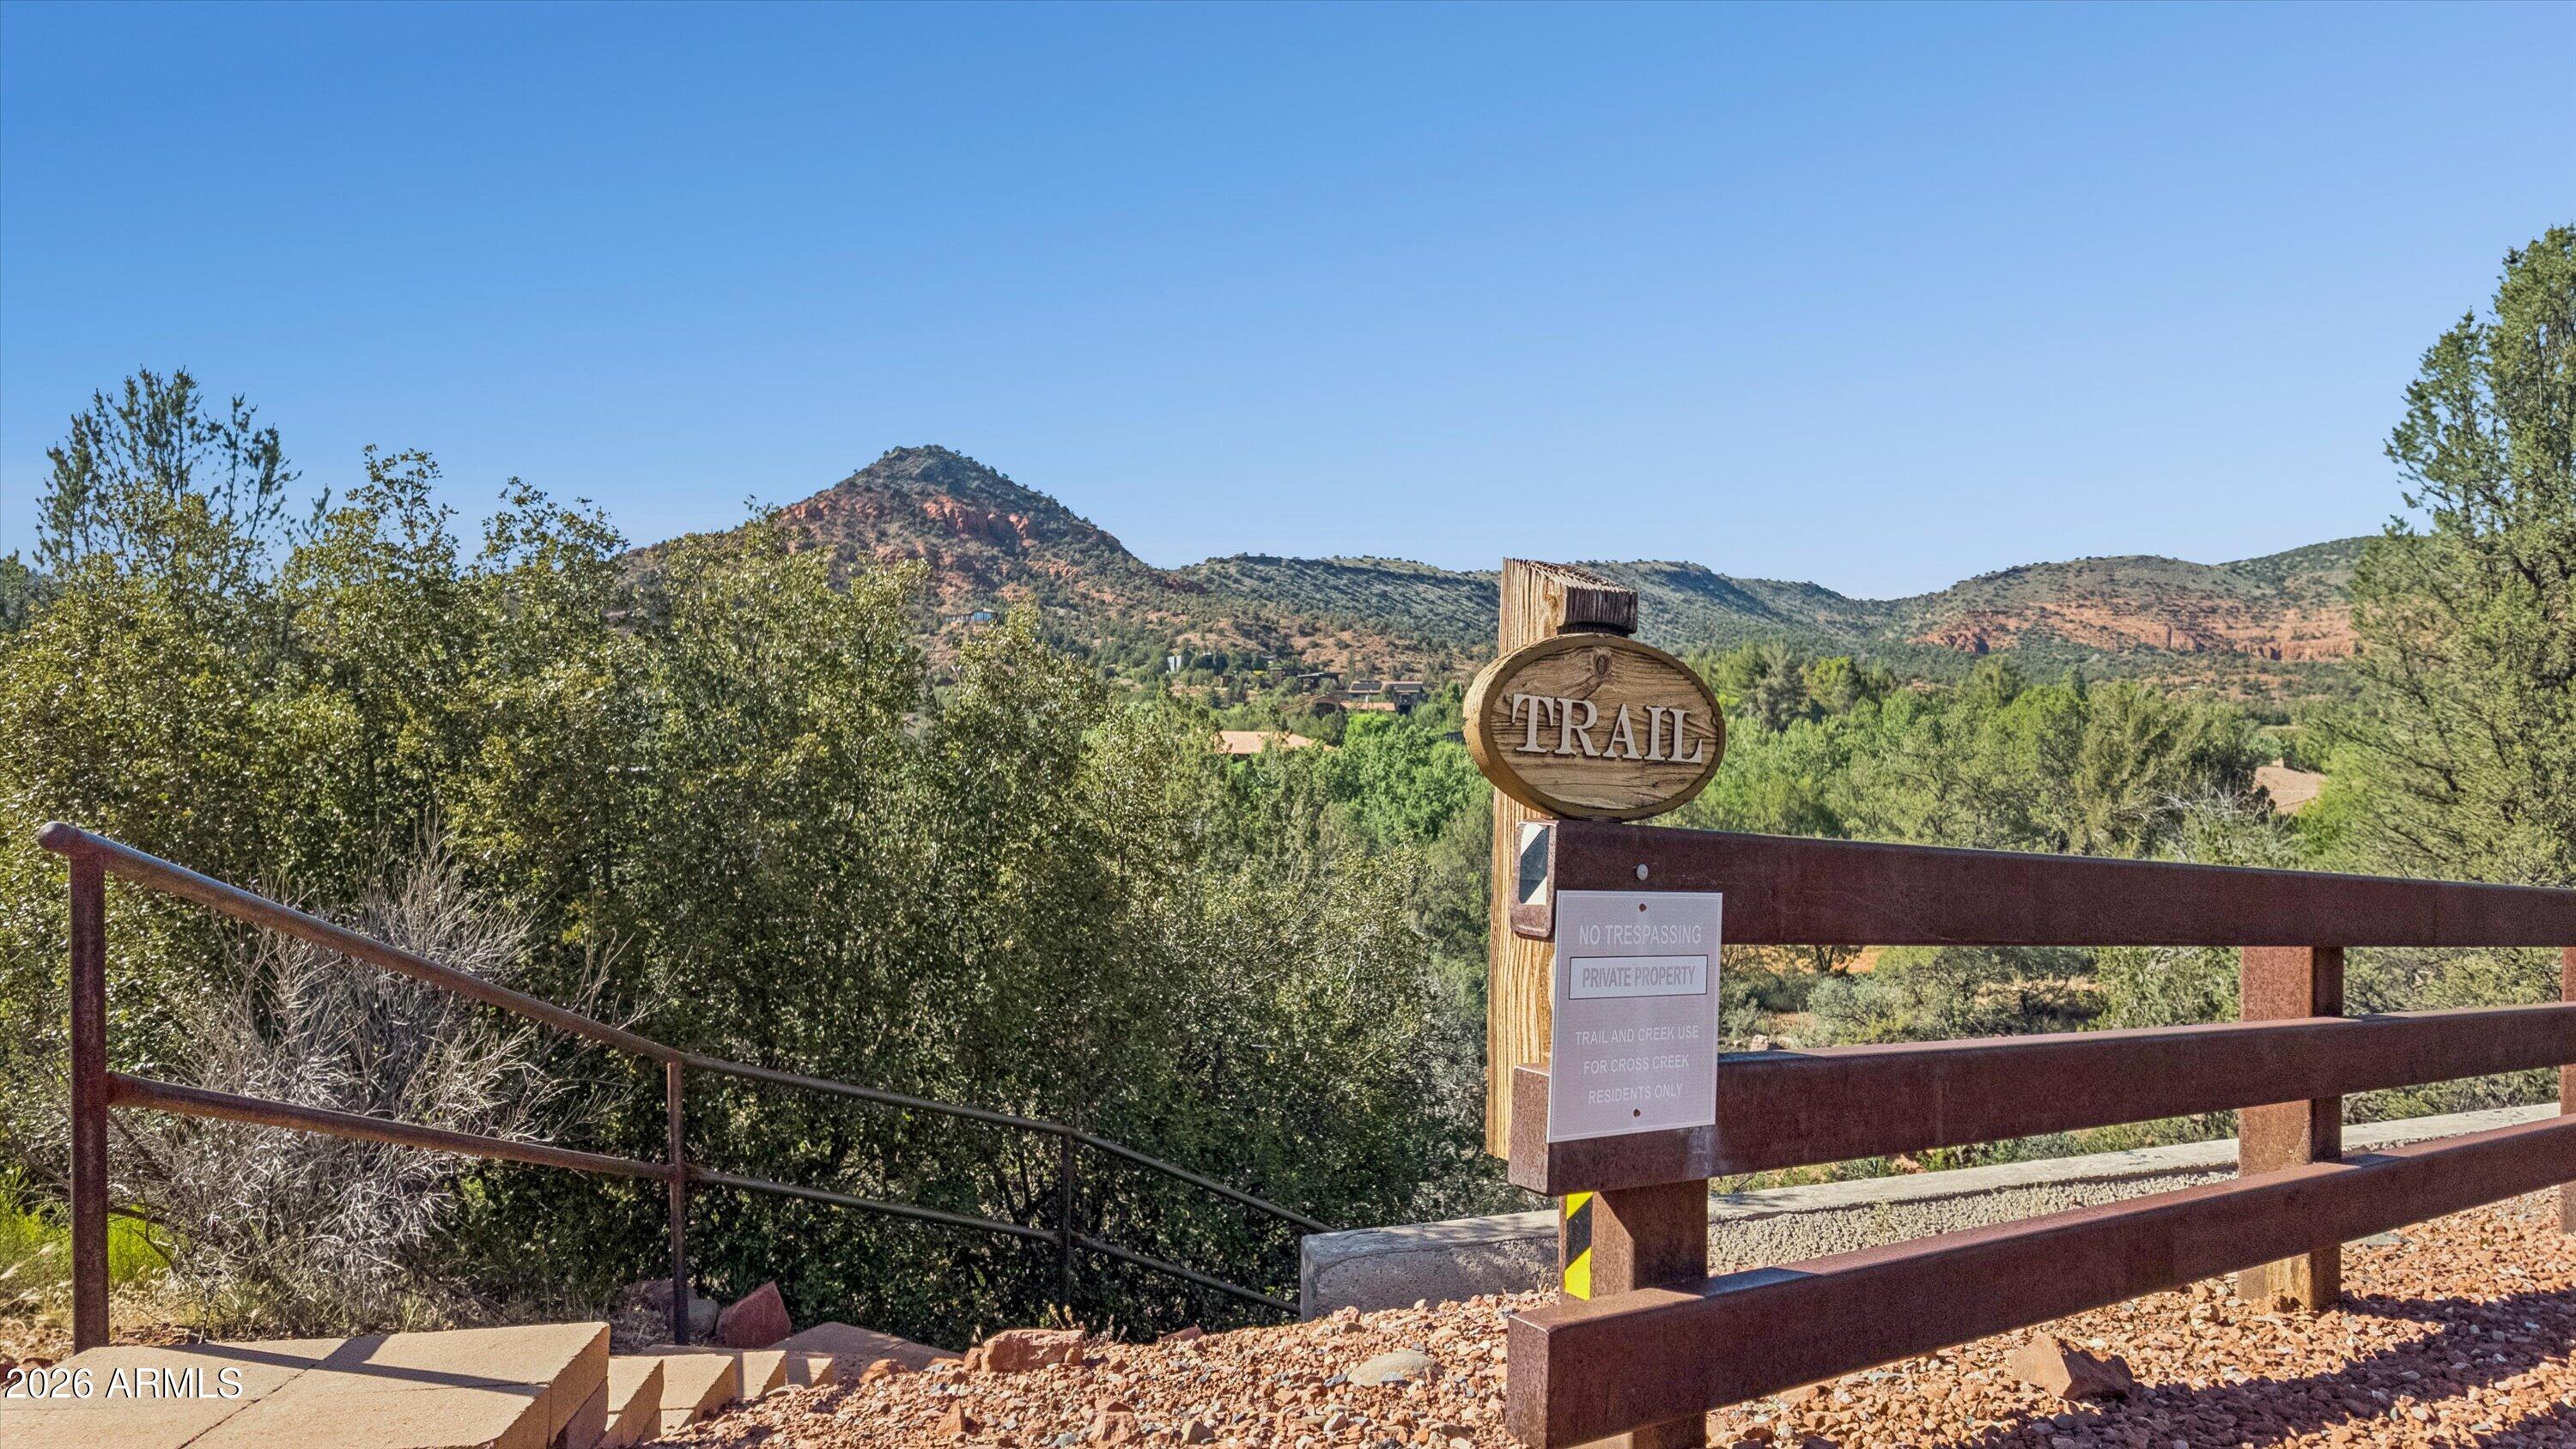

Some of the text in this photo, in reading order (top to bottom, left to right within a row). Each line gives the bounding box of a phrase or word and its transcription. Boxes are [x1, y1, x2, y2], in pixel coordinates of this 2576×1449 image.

[1511, 694, 1703, 764] TRAIL
[1579, 925, 1702, 944] NO TRESPASSING
[1583, 966, 1695, 987] PRIVATE PROPERTY
[1575, 1025, 1699, 1046] TRAIL AND CREEK USE
[1583, 1054, 1689, 1075] FOR CROSS CREEK
[1589, 1082, 1683, 1104] RESIDENTS ONLY
